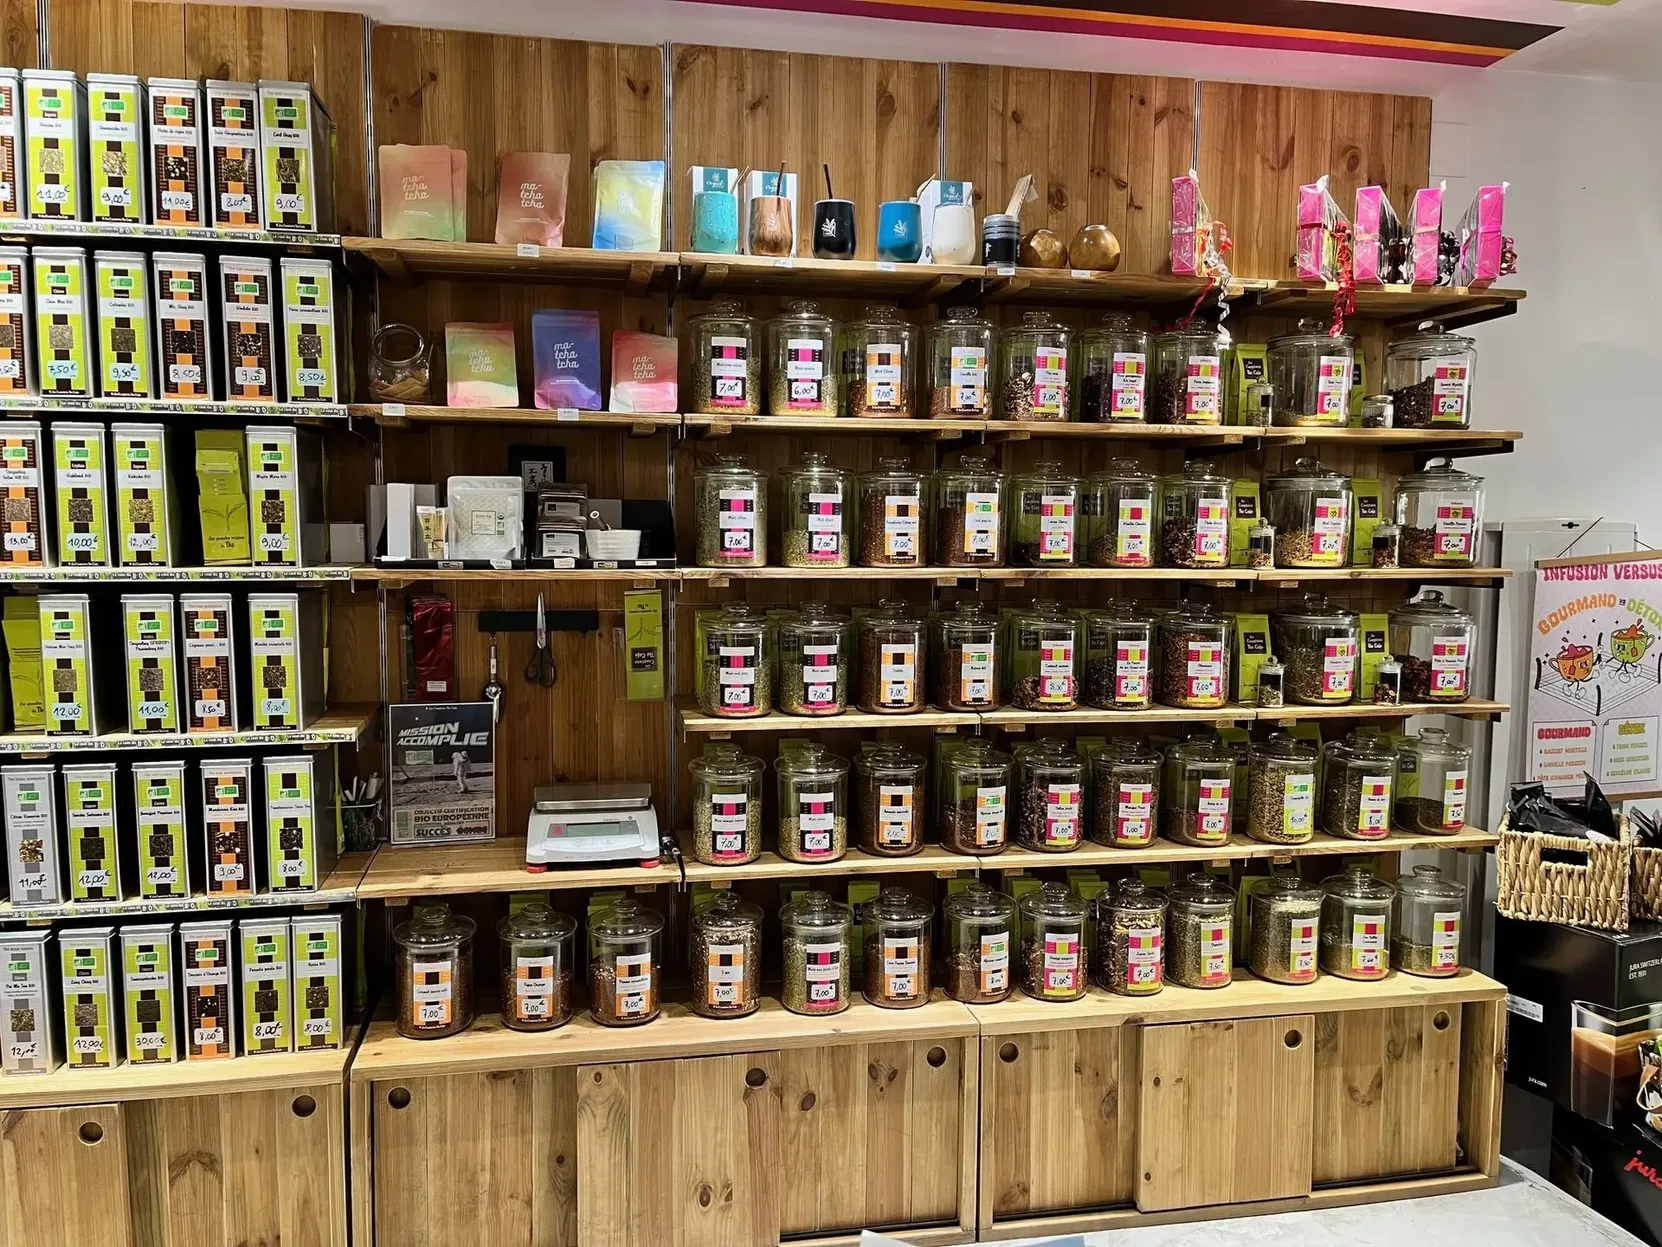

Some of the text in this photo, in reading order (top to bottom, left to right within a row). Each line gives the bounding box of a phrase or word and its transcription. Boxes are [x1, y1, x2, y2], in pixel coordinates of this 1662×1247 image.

[1543, 563, 1609, 582] INFUSION
[1537, 593, 1618, 636] GOURMAND
[398, 721, 460, 738] MISSION
[1537, 726, 1592, 741] GOURMAND
[396, 731, 490, 746] ACCOMPLIE
[443, 806, 490, 815] CERTIFICATION
[414, 815, 431, 823] BIO
